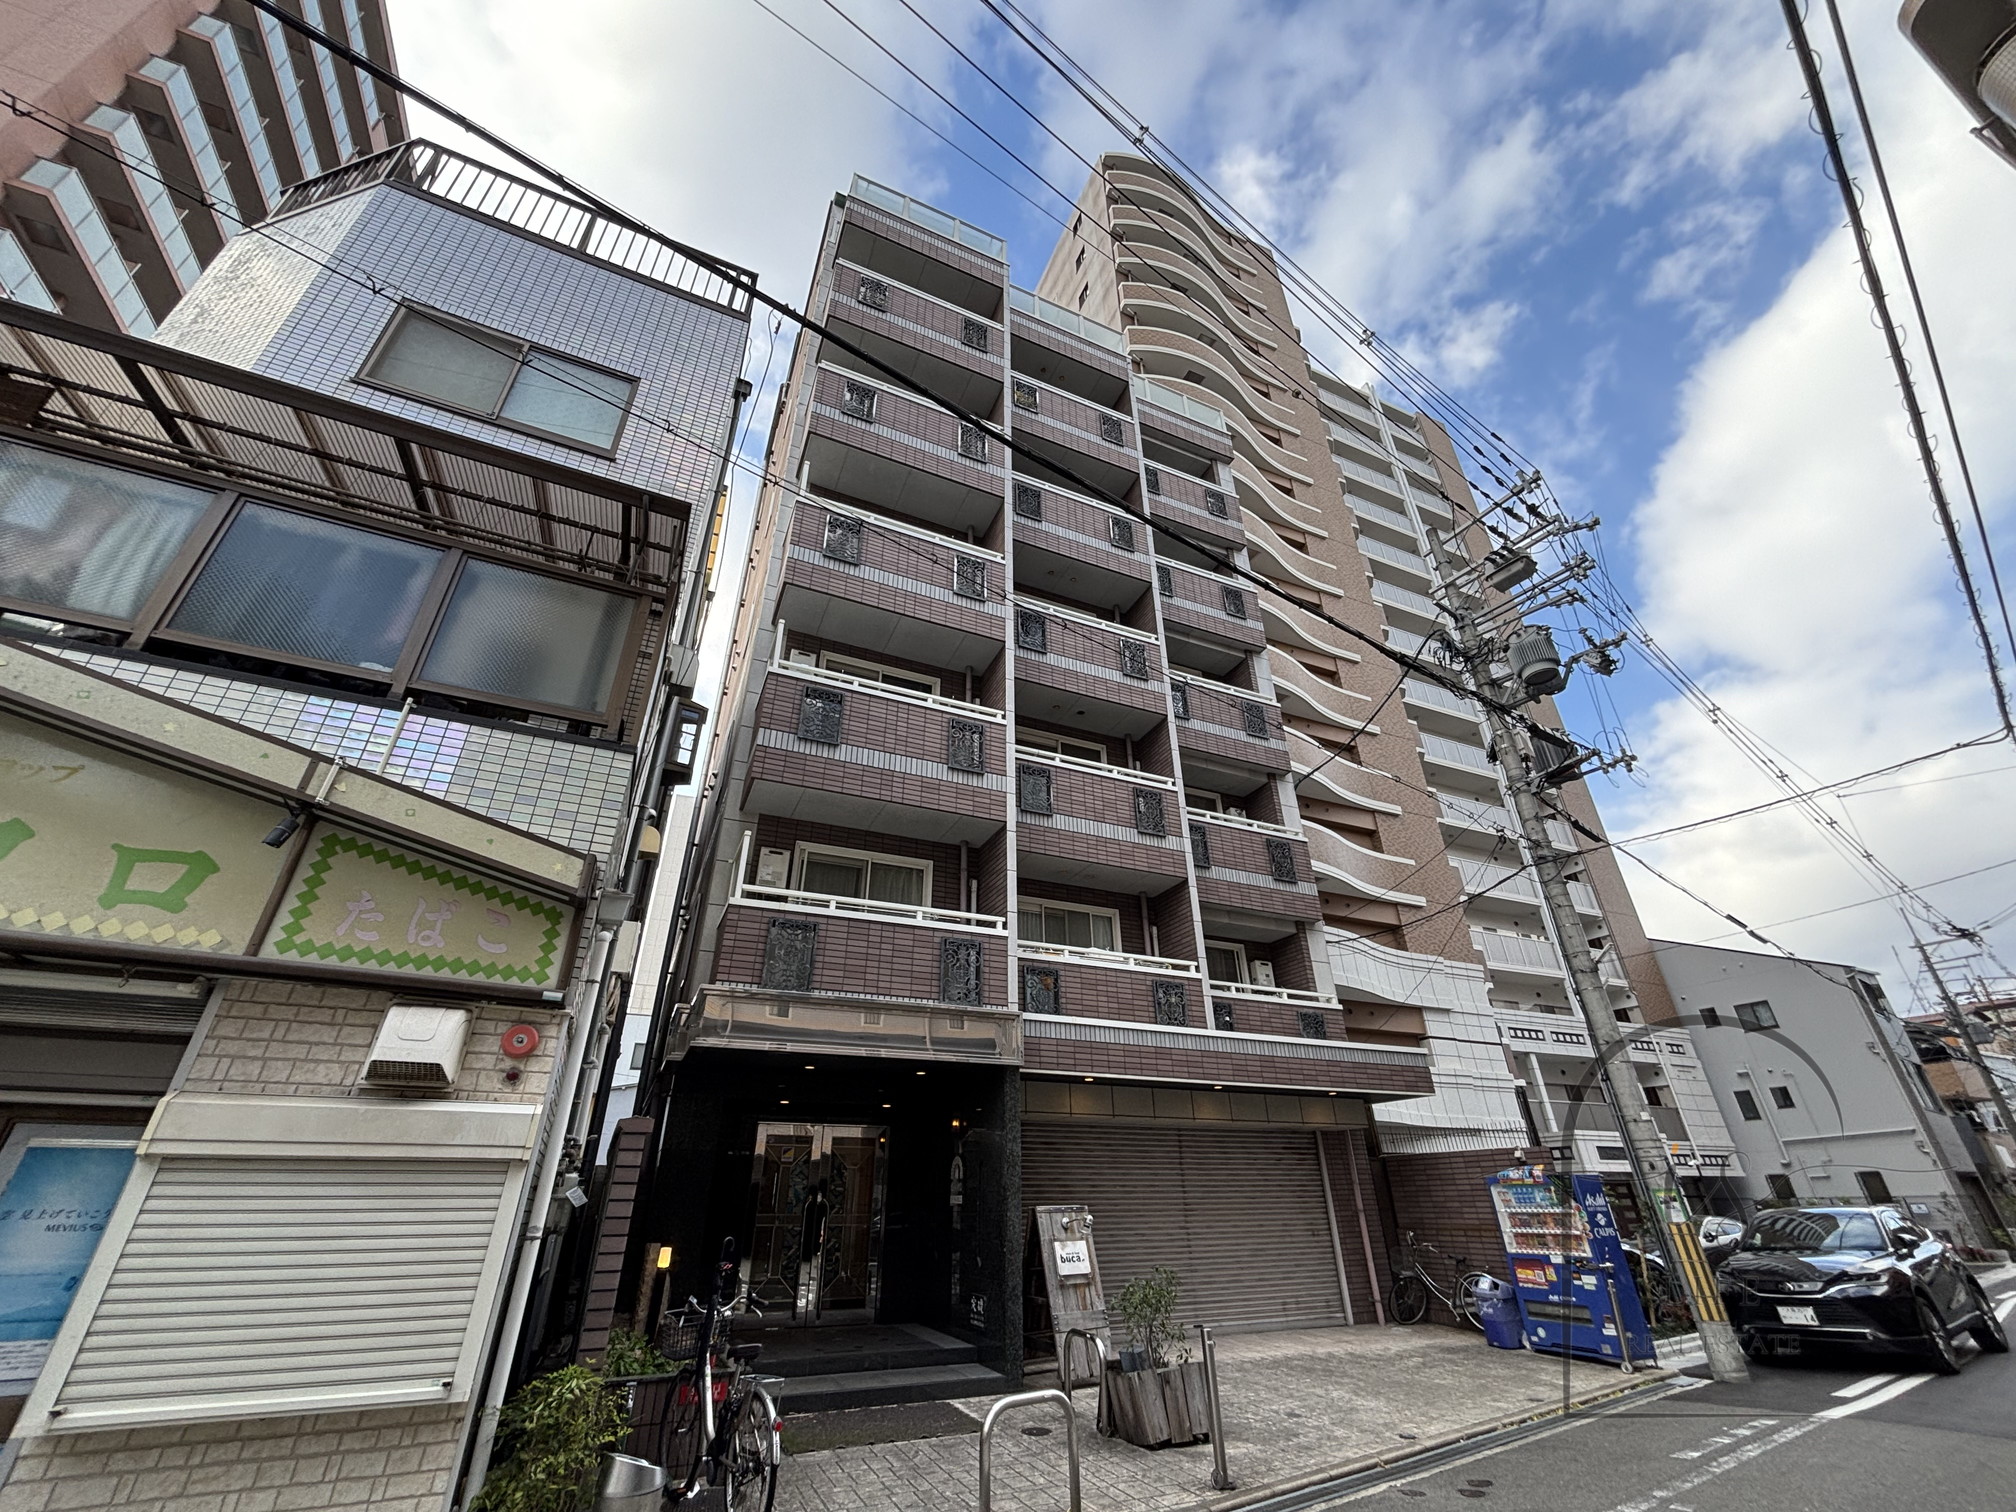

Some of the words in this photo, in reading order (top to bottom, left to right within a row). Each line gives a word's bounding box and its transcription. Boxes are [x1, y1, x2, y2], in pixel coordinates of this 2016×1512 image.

[335, 889, 512, 955] たばこ
[1585, 1192, 1606, 1206] Asahi
[44, 1222, 88, 1233] MEVIUS
[1593, 1227, 1616, 1239] CALPIS
